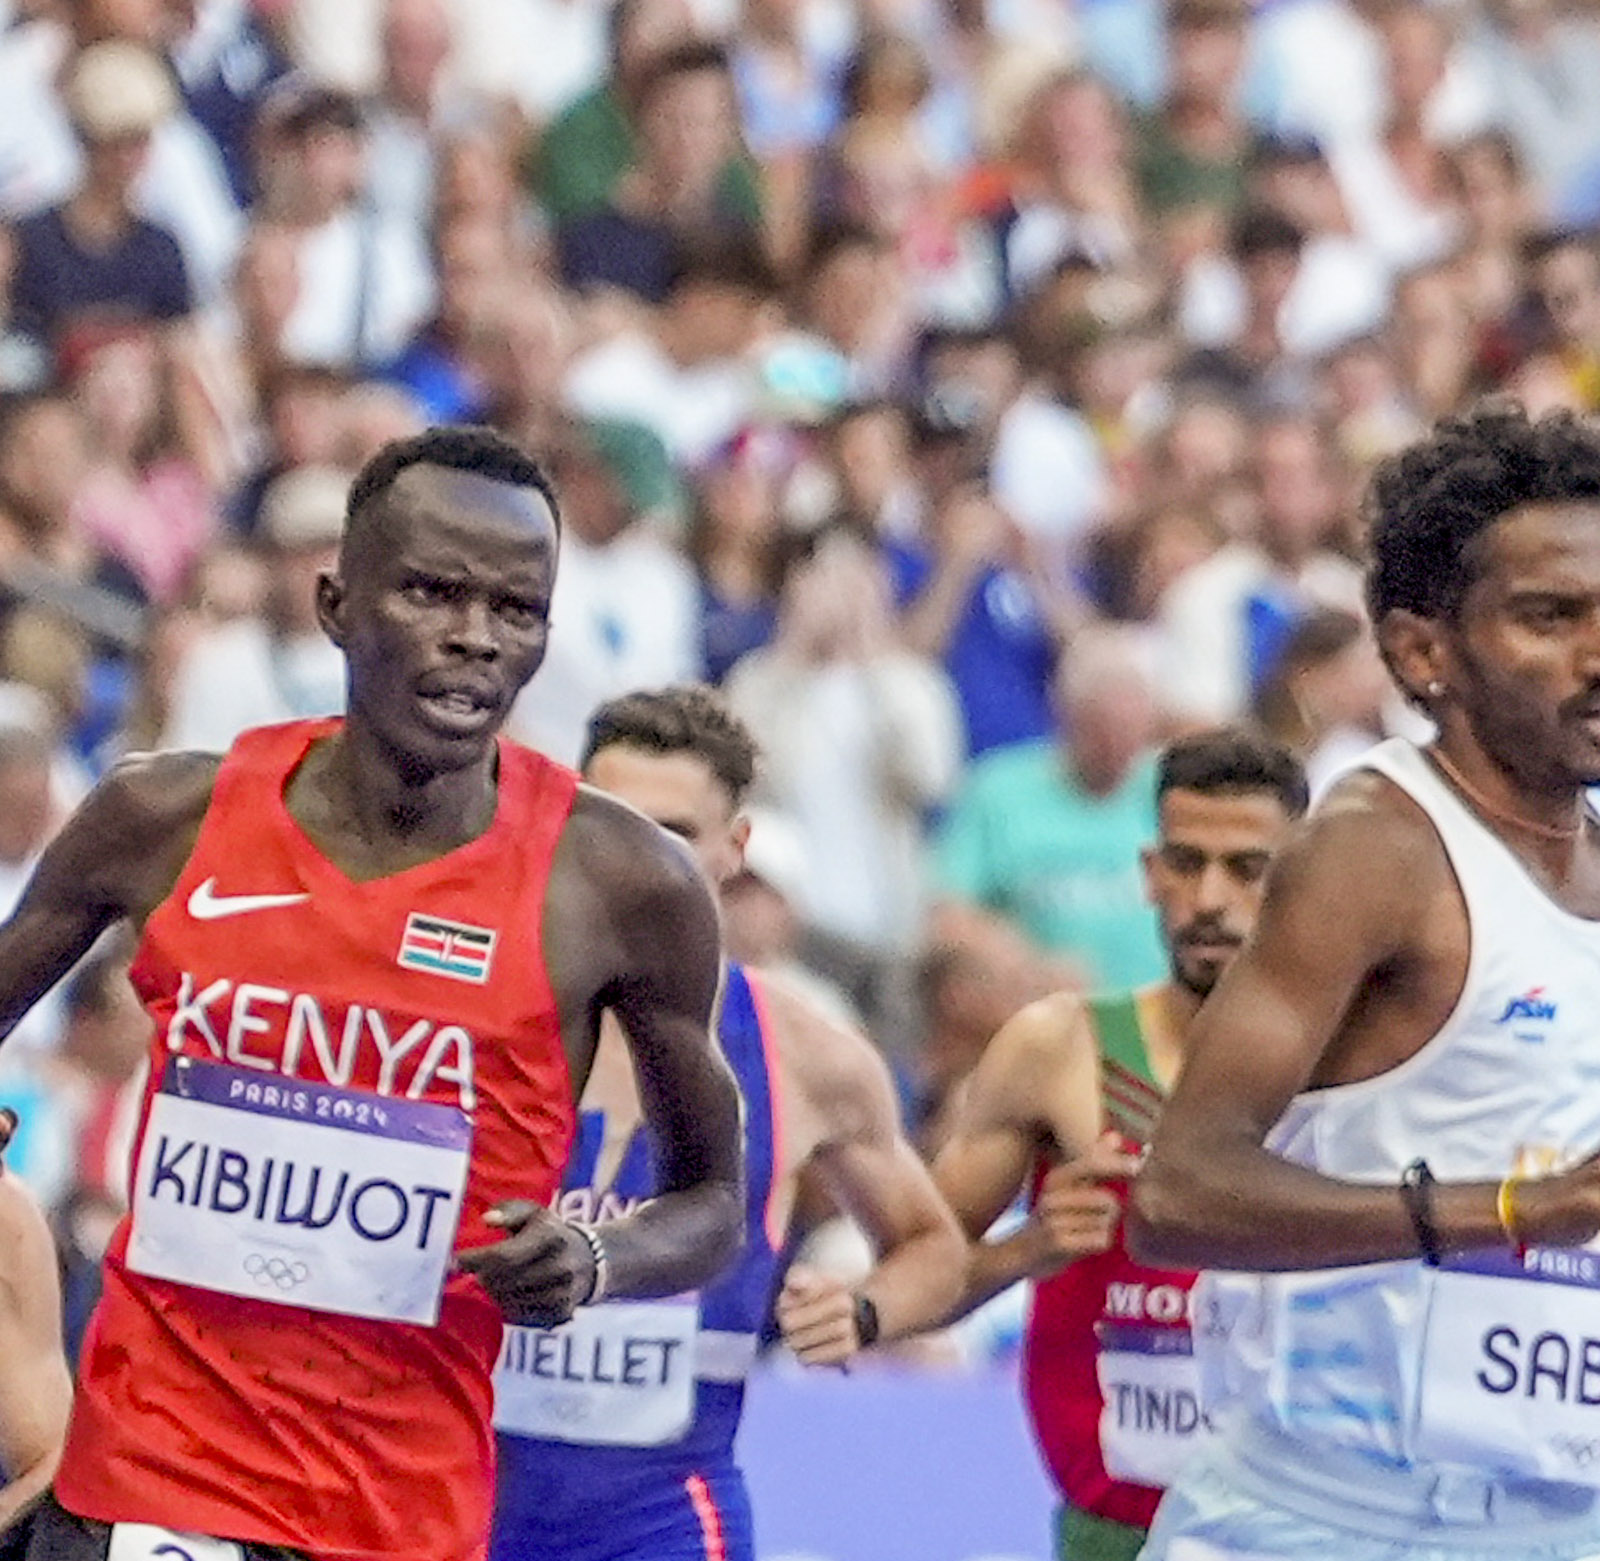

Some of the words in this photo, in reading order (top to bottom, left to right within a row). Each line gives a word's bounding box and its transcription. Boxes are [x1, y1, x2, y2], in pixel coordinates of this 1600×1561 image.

[166, 970, 478, 1111] KENYA
[229, 1078, 308, 1113] PARIS
[315, 1095, 388, 1127] 2024
[148, 1134, 452, 1250] KIBIWOT
[1523, 1248, 1597, 1284] PARIS
[1102, 1280, 1190, 1324] MO
